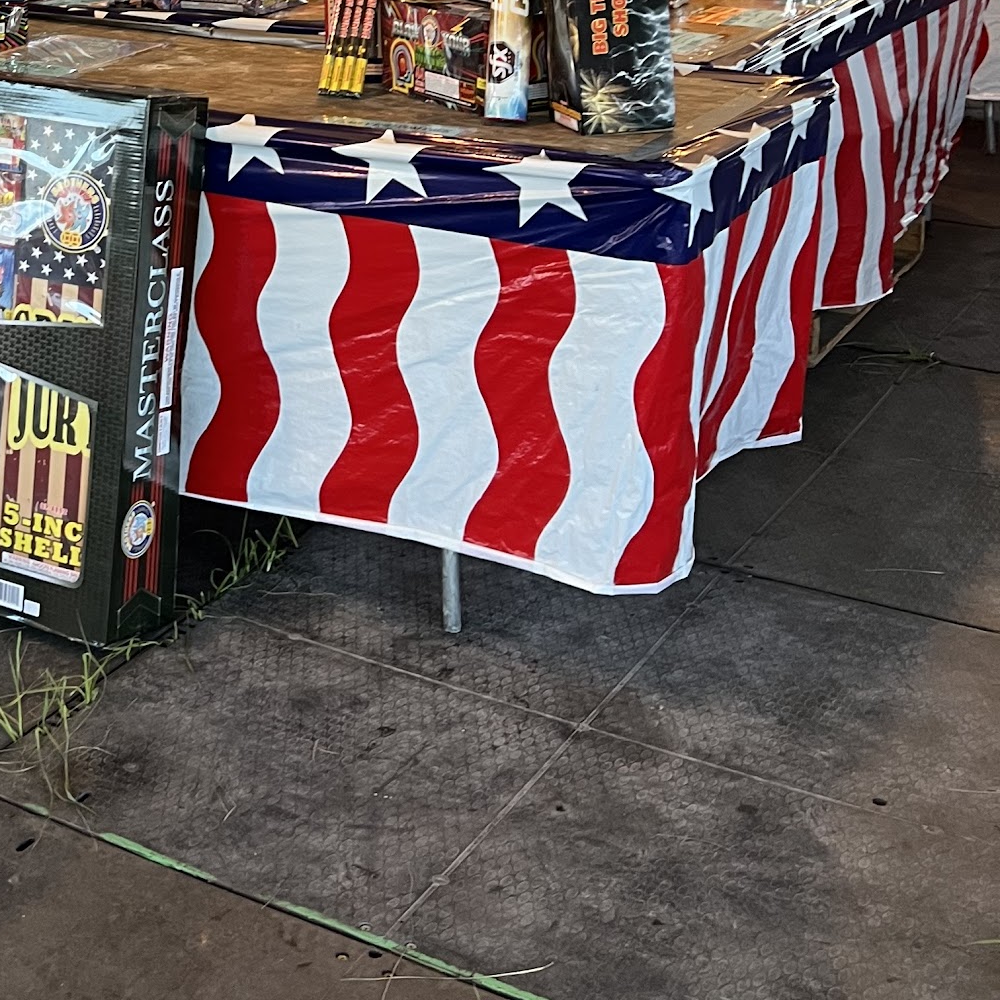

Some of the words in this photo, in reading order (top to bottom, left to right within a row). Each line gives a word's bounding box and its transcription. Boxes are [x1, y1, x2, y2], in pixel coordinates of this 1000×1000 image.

[591, 17, 609, 55] BIG
[133, 178, 175, 483] MASTERCLASS
[13, 380, 90, 448] JUK
[3, 501, 84, 543] 5-INC
